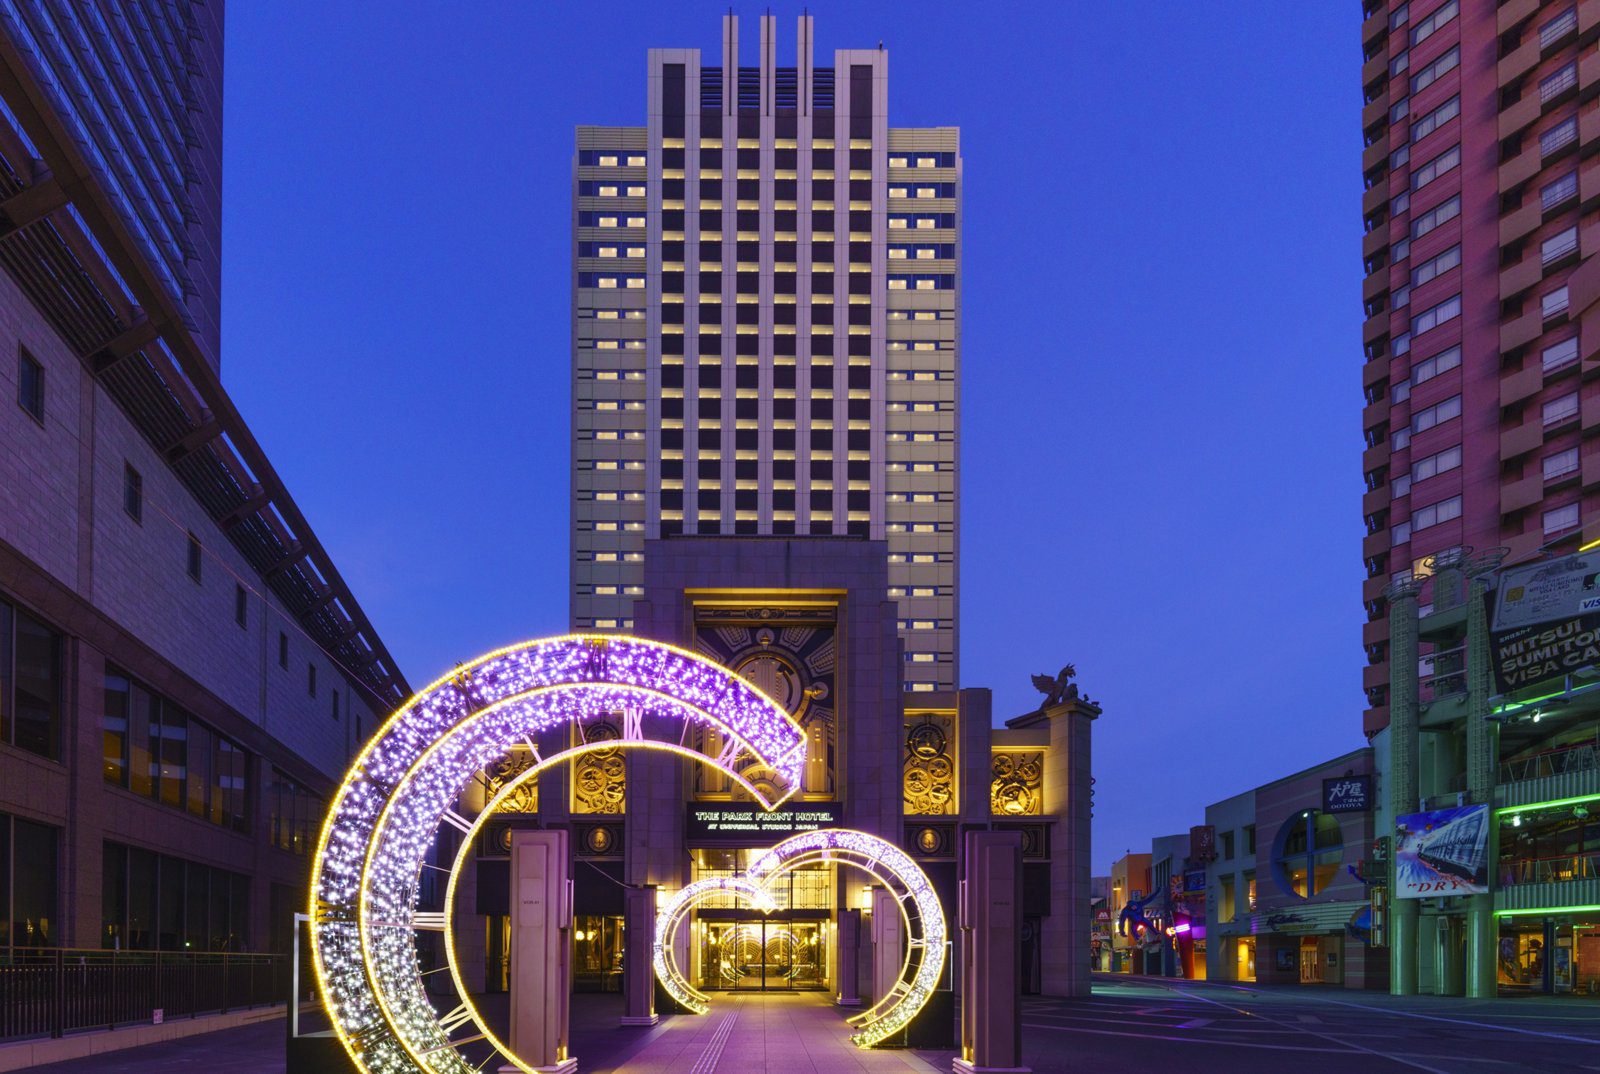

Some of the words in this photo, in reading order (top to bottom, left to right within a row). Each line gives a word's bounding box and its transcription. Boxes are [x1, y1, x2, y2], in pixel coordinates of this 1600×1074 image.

[1500, 619, 1582, 659] MITSUI
[1504, 660, 1559, 685] VISA
[1330, 781, 1364, 801] 大戸屋
[695, 811, 720, 821] THE
[721, 811, 753, 821] PARK
[755, 811, 793, 821] FRONT
[795, 811, 834, 822] HOTEL
